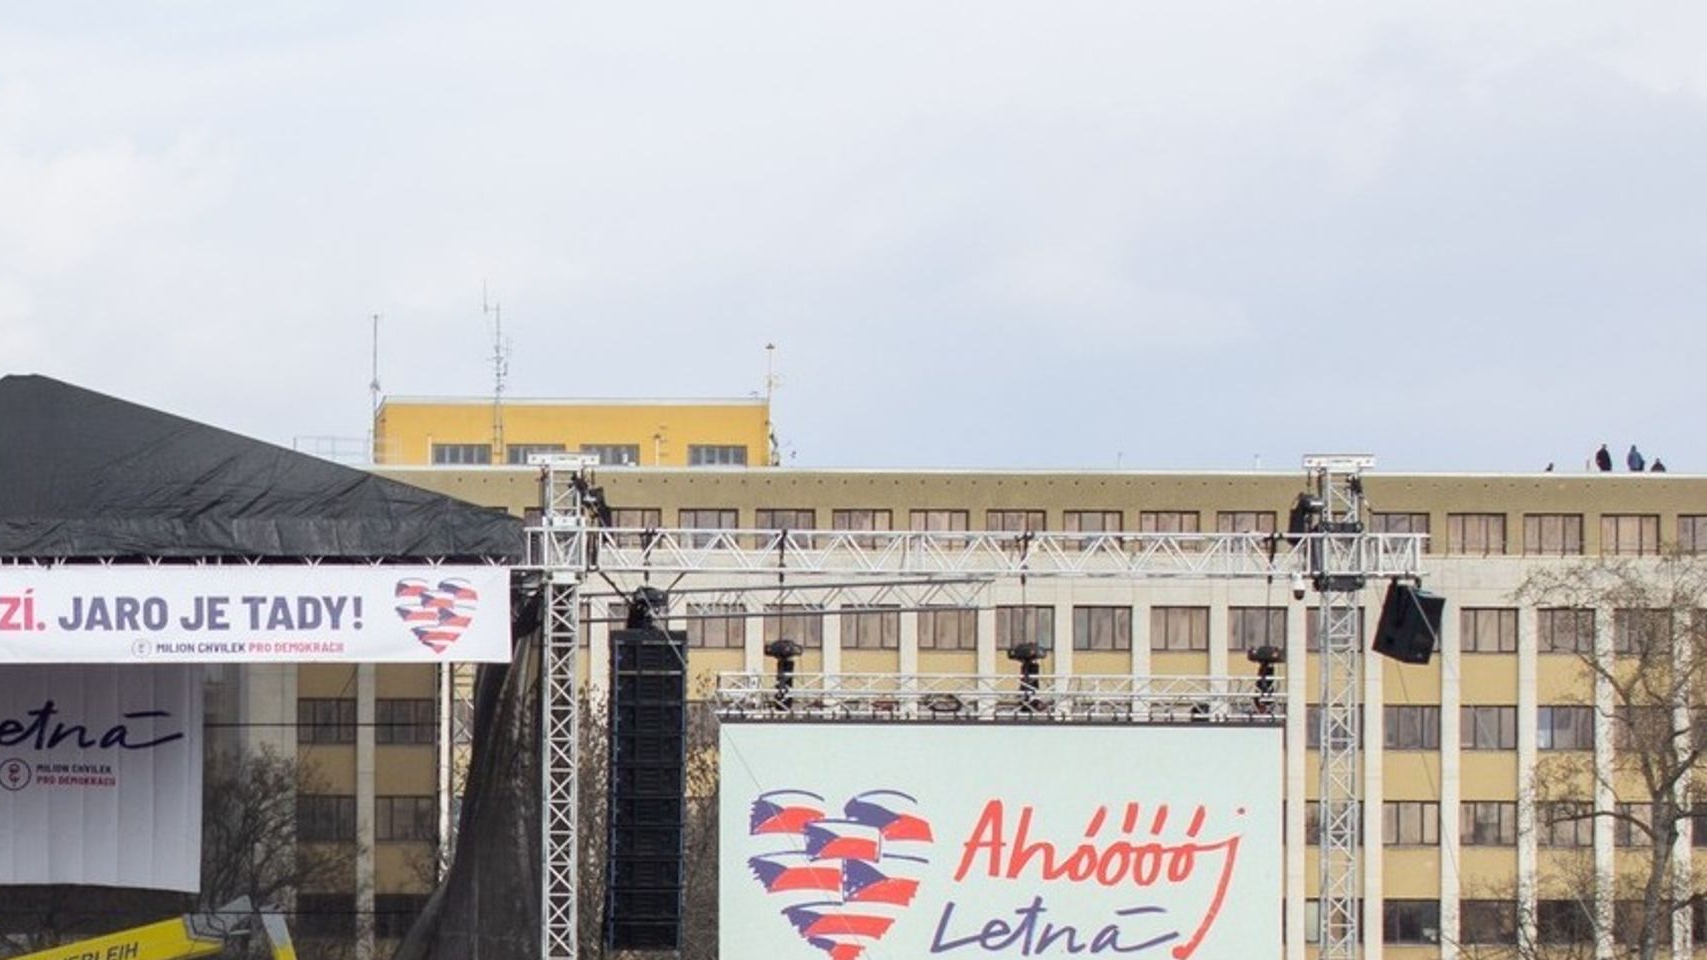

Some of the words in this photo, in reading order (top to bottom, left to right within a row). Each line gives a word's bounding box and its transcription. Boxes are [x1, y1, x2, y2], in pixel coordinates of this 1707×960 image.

[57, 596, 168, 631] JARO
[180, 596, 230, 631] JE
[242, 596, 364, 631] TADY!
[156, 643, 196, 653] MILION
[198, 643, 245, 653] CHVILEK
[249, 643, 271, 653] PRO
[929, 896, 1181, 957] Letná
